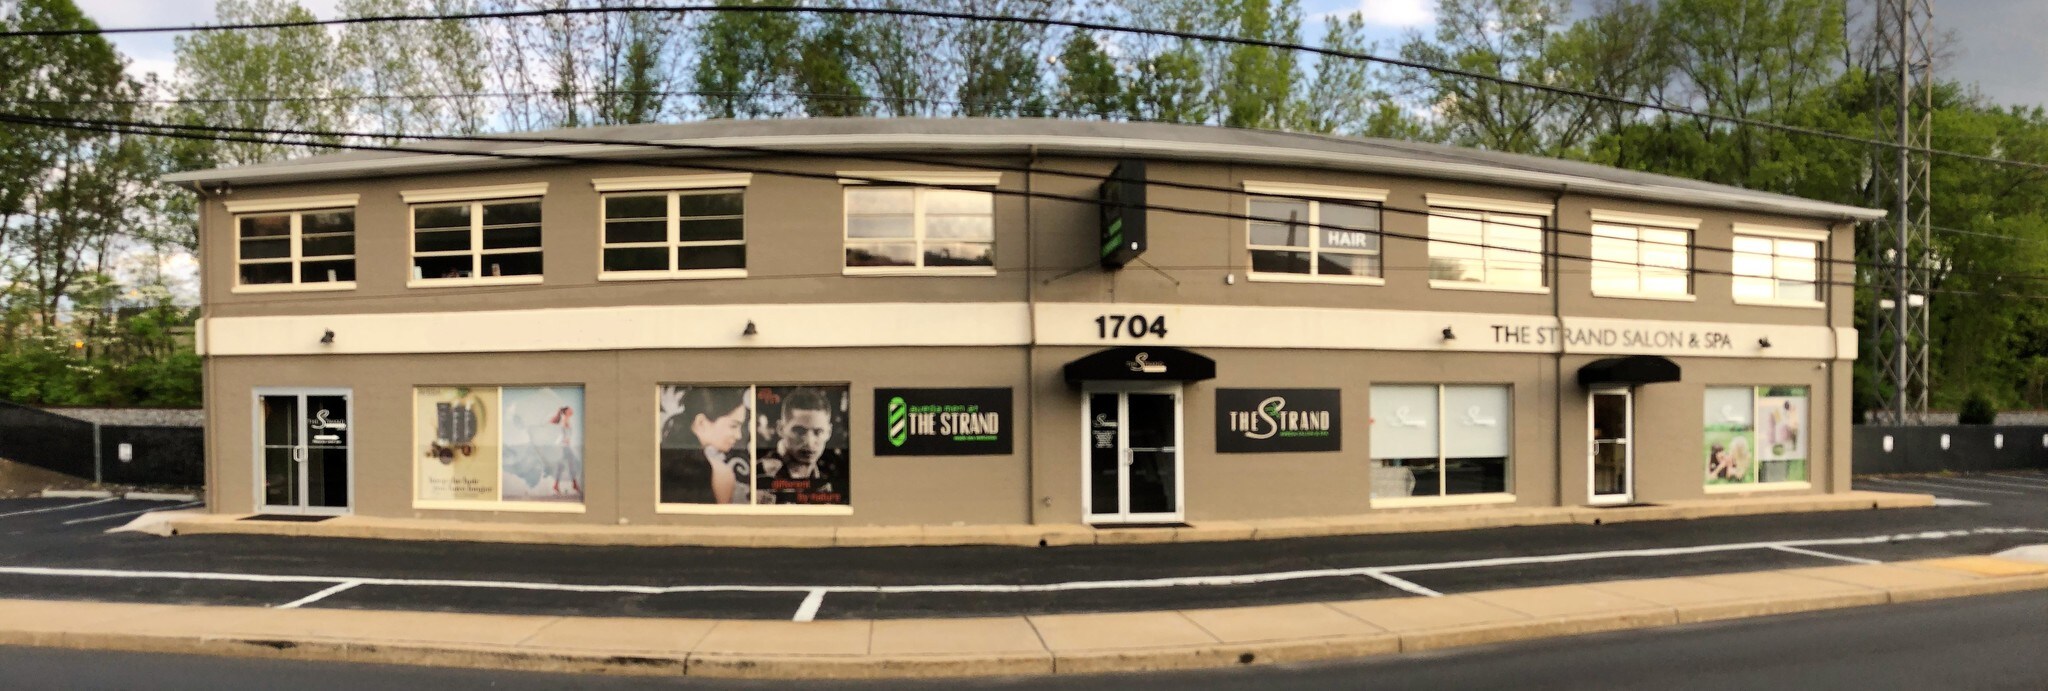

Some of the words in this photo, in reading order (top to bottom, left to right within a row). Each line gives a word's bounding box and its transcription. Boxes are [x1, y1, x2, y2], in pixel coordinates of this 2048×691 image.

[1327, 231, 1367, 247] HAIR
[1095, 315, 1167, 338] 1704
[1491, 324, 1531, 344] THE
[1537, 326, 1618, 347] STRAND
[1622, 329, 1684, 349] SALON
[1688, 332, 1699, 348] &
[1704, 332, 1733, 349] SPA
[908, 412, 937, 436] THE
[940, 412, 999, 436] STRAND
[1229, 411, 1259, 432] THE
[1244, 396, 1330, 440] STRAND
